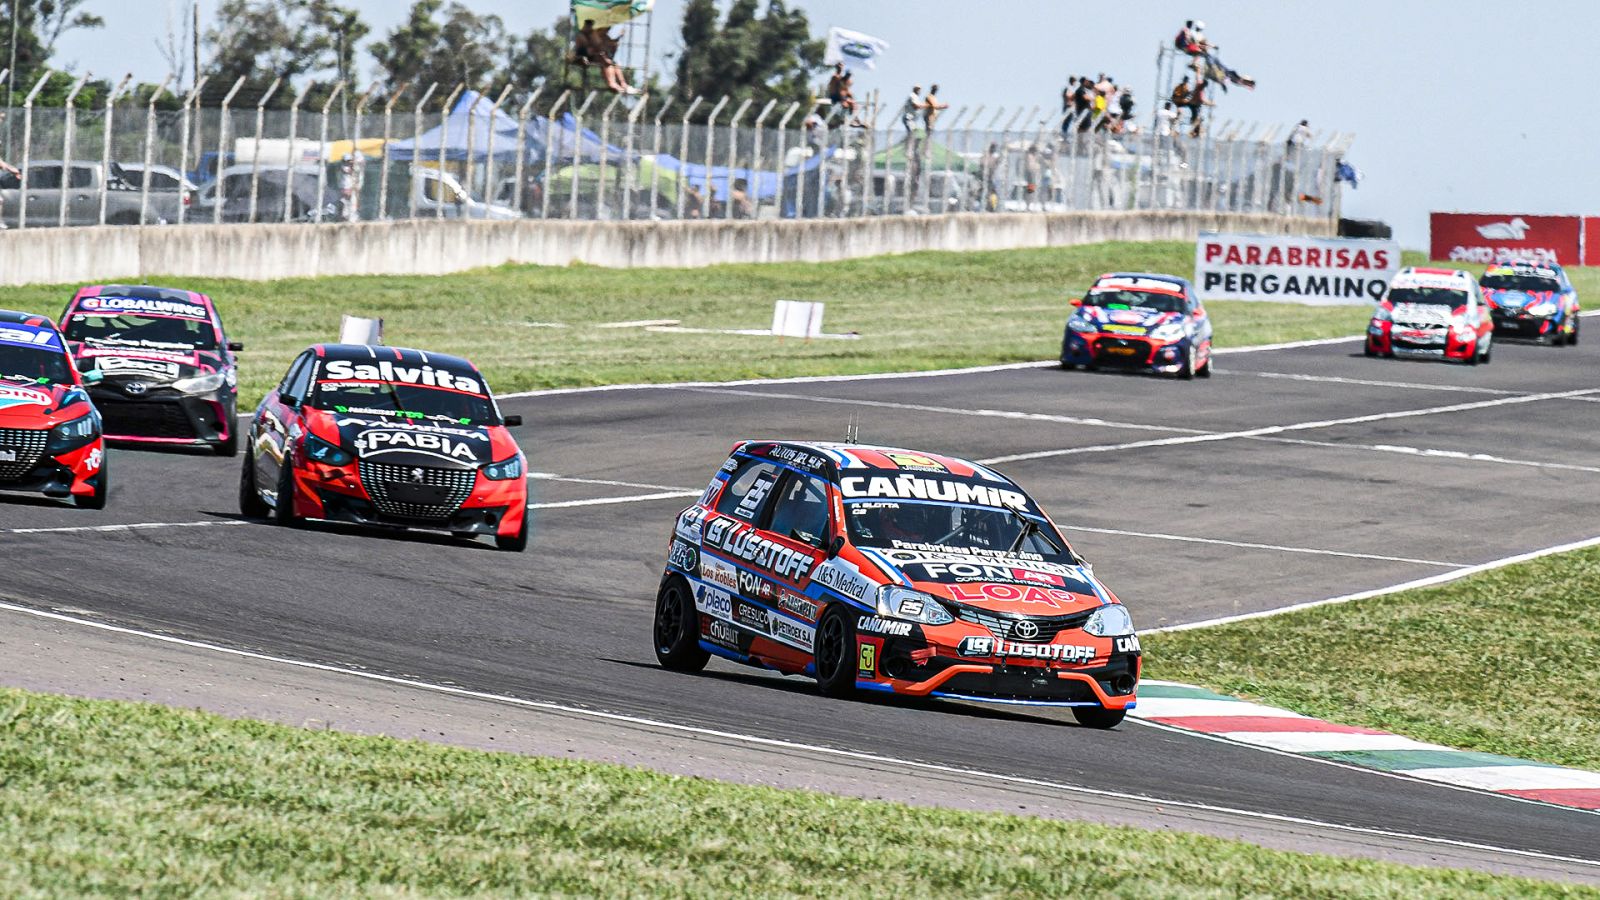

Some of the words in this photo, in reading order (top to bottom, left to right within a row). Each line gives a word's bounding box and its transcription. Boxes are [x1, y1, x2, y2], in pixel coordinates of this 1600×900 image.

[1205, 243, 1389, 270] PARABRISAS
[1204, 272, 1388, 300] PERGAMINO
[82, 297, 206, 316] GLOBALWING
[325, 360, 481, 393] Salvita
[367, 431, 478, 461] PABIA
[891, 539, 969, 555] Parabrisas
[715, 570, 737, 589] Robles
[922, 562, 1014, 579] FON
[739, 570, 762, 596] FON
[833, 571, 870, 600] Medical
[705, 590, 731, 613] placo
[900, 601, 923, 615] 25
